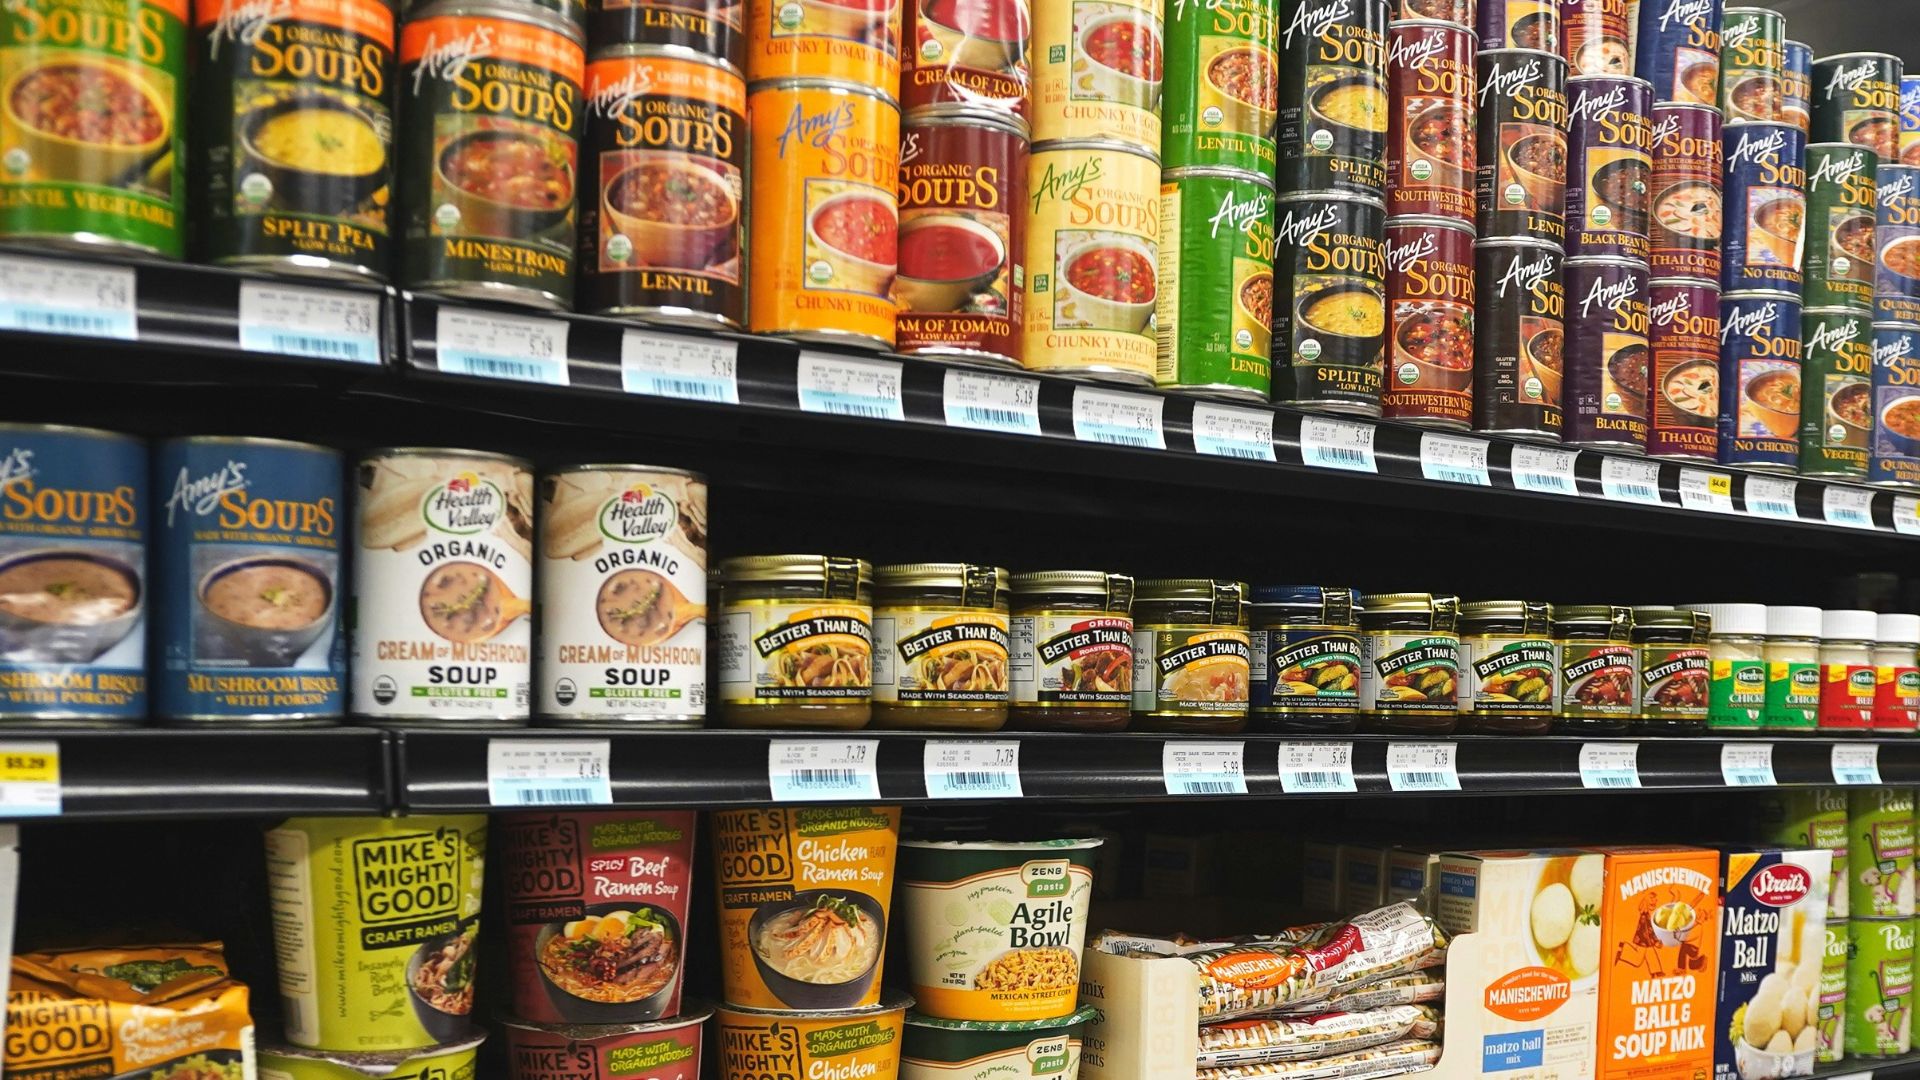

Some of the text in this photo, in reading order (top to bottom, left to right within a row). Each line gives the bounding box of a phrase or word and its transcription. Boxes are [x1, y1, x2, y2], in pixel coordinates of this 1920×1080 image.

[645, 8, 715, 37] LENTIL
[252, 25, 383, 97] SOUPS
[1479, 58, 1544, 107] Amy's
[1826, 59, 1878, 99] Amy's
[451, 62, 573, 131] SOUPS
[1063, 105, 1126, 120] CHUNKY
[1281, 107, 1300, 115] GLUTEN
[1567, 85, 1629, 132] Amy's
[616, 100, 733, 159] SOUPS
[778, 102, 858, 159] Amy's
[1198, 136, 1245, 153] LENTIL
[1728, 129, 1787, 173] Amy's
[913, 164, 971, 177] ORGANIC
[1330, 159, 1370, 178] SPLIT
[1809, 152, 1864, 190] Amy's
[1034, 157, 1102, 214] Amy's
[1070, 187, 1158, 236] SOUPS
[1208, 191, 1268, 238] Amy's
[1275, 206, 1342, 258] Amy's
[1334, 233, 1377, 250] ORGANIC
[1581, 232, 1617, 246] BLACK
[1307, 233, 1385, 280] SOUPS
[1497, 254, 1555, 297] Amy's
[1744, 267, 1757, 278] NO
[641, 271, 712, 295] LENTIL
[796, 295, 852, 312] CHUNKY
[1581, 276, 1638, 318] Amy's
[925, 319, 1009, 336] OF TOMATO
[1720, 302, 1779, 346] Amy's
[920, 333, 937, 341] LOW
[1047, 335, 1110, 350] CHUNKY
[1804, 318, 1860, 360] Amy's
[1318, 367, 1360, 383] SPLIT
[1015, 388, 1034, 404] 5.19
[1383, 395, 1456, 409] SOUTHWESTERN
[1137, 416, 1153, 430] 5.19
[1596, 418, 1626, 430] BLACK
[1355, 430, 1370, 444] 5.19
[1660, 431, 1690, 443] THAI
[1734, 441, 1751, 452] NO
[4, 478, 135, 527] SOUPS
[165, 460, 250, 527] Amy's
[219, 489, 335, 536] SOUPS
[610, 502, 664, 522] Health
[622, 519, 669, 538] Valley
[418, 541, 506, 569] ORGANIC
[595, 549, 679, 576] ORGANIC
[813, 608, 859, 617] ORGANIC
[955, 615, 999, 625] ORGANIC
[1089, 619, 1130, 629] ORGANIC
[758, 622, 810, 653] BETTER
[813, 619, 848, 635] THAN
[903, 626, 987, 657] BETTER THAN
[1043, 631, 1120, 659] BETTER THAN
[1275, 634, 1287, 642] 38
[377, 641, 433, 661] CREAM
[559, 645, 625, 665] CREAM OF
[1161, 643, 1235, 671] BETTER THAN
[1276, 642, 1347, 667] BETTER THAN
[1381, 648, 1448, 673] BETTER THAN
[1479, 651, 1545, 675] BETTER THAN
[1567, 655, 1626, 679] BETTER THAN
[1646, 660, 1705, 682] BETTER THAN
[187, 674, 298, 693] MUSHROOM
[429, 666, 497, 685] SOUP
[605, 668, 670, 685] SOUP
[604, 688, 646, 698] GLUTEN
[758, 689, 845, 697] MADE WITH SEASONED
[901, 692, 922, 700] MADE
[924, 692, 946, 700] WITH
[1096, 693, 1120, 701] SEASONED
[847, 745, 866, 760] 7.79
[996, 748, 1014, 764] 7.79
[1332, 751, 1347, 764] 5.69
[1434, 752, 1448, 765] 6.79
[1223, 761, 1239, 774] 5.99
[800, 819, 848, 833] ORGANIC
[363, 838, 456, 867] MIKE'S
[719, 833, 783, 854] MIGHTY
[797, 839, 868, 863] Chicken
[591, 856, 670, 878] SPICY Beef
[722, 853, 784, 877] GOOD
[802, 862, 884, 886] Ramen Soup
[1032, 867, 1062, 876] ZENB
[366, 861, 455, 890] MIGHTY
[1620, 867, 1712, 900] MANISCHEWITZ
[594, 876, 679, 899] Ramen Soup
[750, 891, 792, 903] RAMEN
[980, 885, 1015, 897] protein
[1036, 882, 1065, 893] pasta
[368, 882, 455, 917] GOOD
[538, 906, 582, 919] RAMEN
[1010, 900, 1073, 931] Agile
[1726, 907, 1778, 936] Matzo
[365, 920, 457, 946] CRAFT RAMEN
[1010, 923, 1070, 949] Bowl
[1732, 936, 1768, 969] Ball
[1740, 972, 1757, 983] Mix
[991, 991, 1056, 1001] MEXICAN STREET
[1489, 982, 1568, 1006] MANISCHEWITZ
[1632, 976, 1695, 1005] MATZO
[1634, 1005, 1690, 1030] BALL &
[5, 1023, 102, 1057] GOOD
[723, 1032, 794, 1052] MIKE'S
[813, 1026, 870, 1042] MADE WITH
[1613, 1032, 1664, 1060] SOUP
[1671, 1025, 1706, 1051] MIX
[612, 1042, 671, 1060] MADE WITH
[812, 1040, 858, 1054] ORGANIC
[1037, 1044, 1062, 1054] ZENB
[1485, 1041, 1519, 1055] matzo
[1522, 1037, 1541, 1051] ball
[519, 1050, 591, 1071] MIKE'S
[611, 1056, 657, 1072] ORGANIC
[727, 1054, 794, 1072] MIGHTY
[809, 1057, 876, 1080] Chicken
[1041, 1058, 1064, 1070] pasta
[1506, 1053, 1521, 1064] mix
